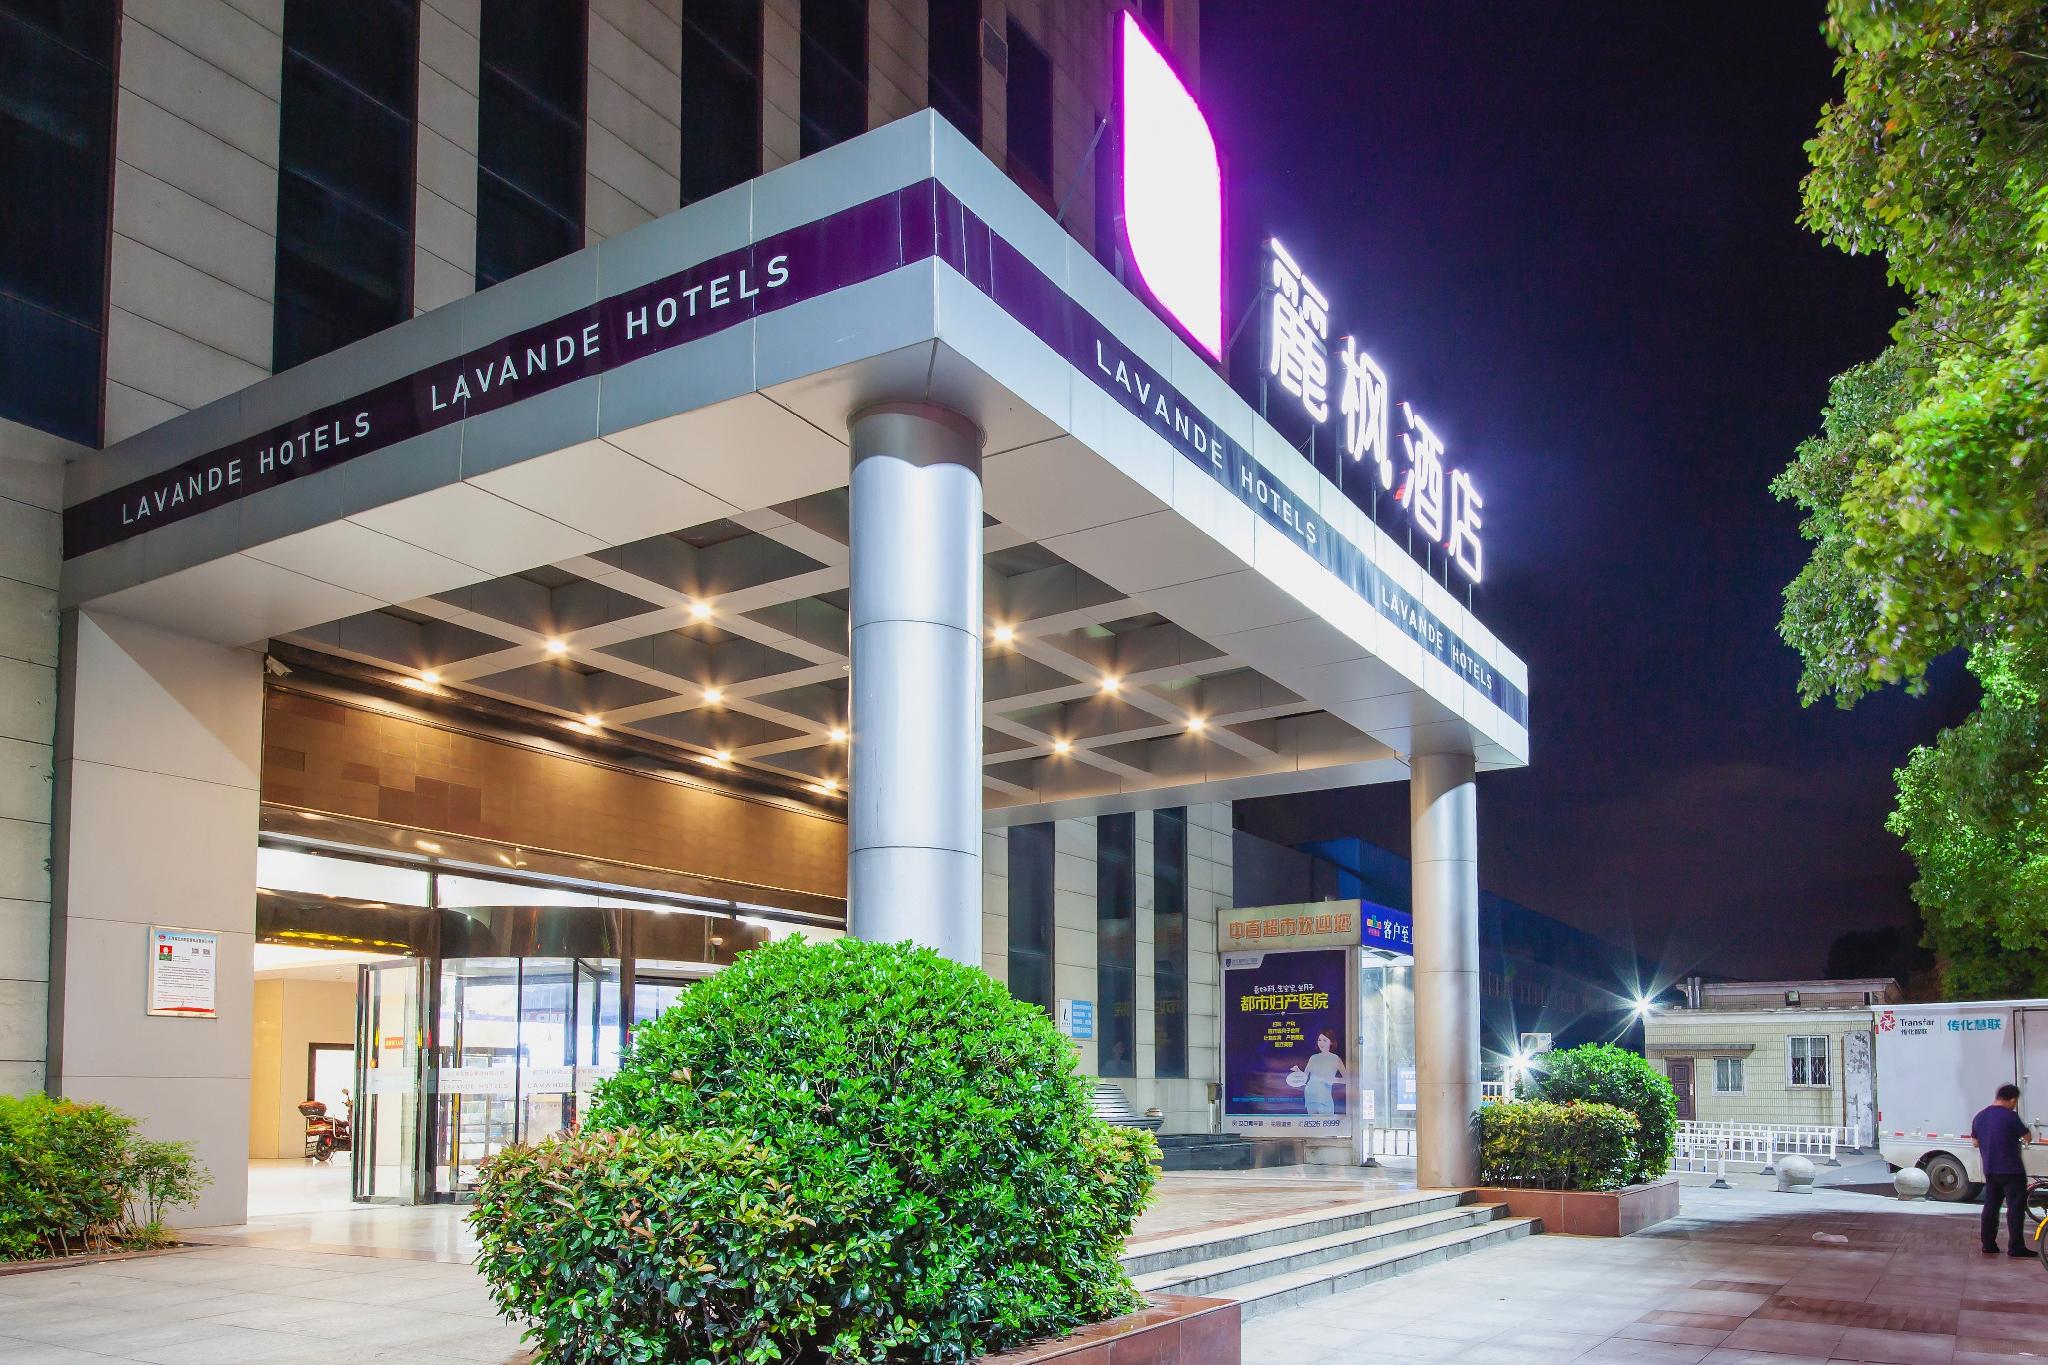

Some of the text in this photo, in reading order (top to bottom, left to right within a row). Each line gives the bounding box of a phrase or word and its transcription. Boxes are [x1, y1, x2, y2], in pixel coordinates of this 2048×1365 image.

[430, 255, 790, 411] LAVANDE HOTELS
[122, 411, 372, 525] LAVANDE HOTELS
[1096, 339, 1317, 544] LAVANDE HOTELS
[1381, 585, 1494, 690] LAVANDE HOTELS
[1229, 914, 1352, 939] 中百超市欢迎您
[1240, 992, 1329, 1012] 都市妇产医院
